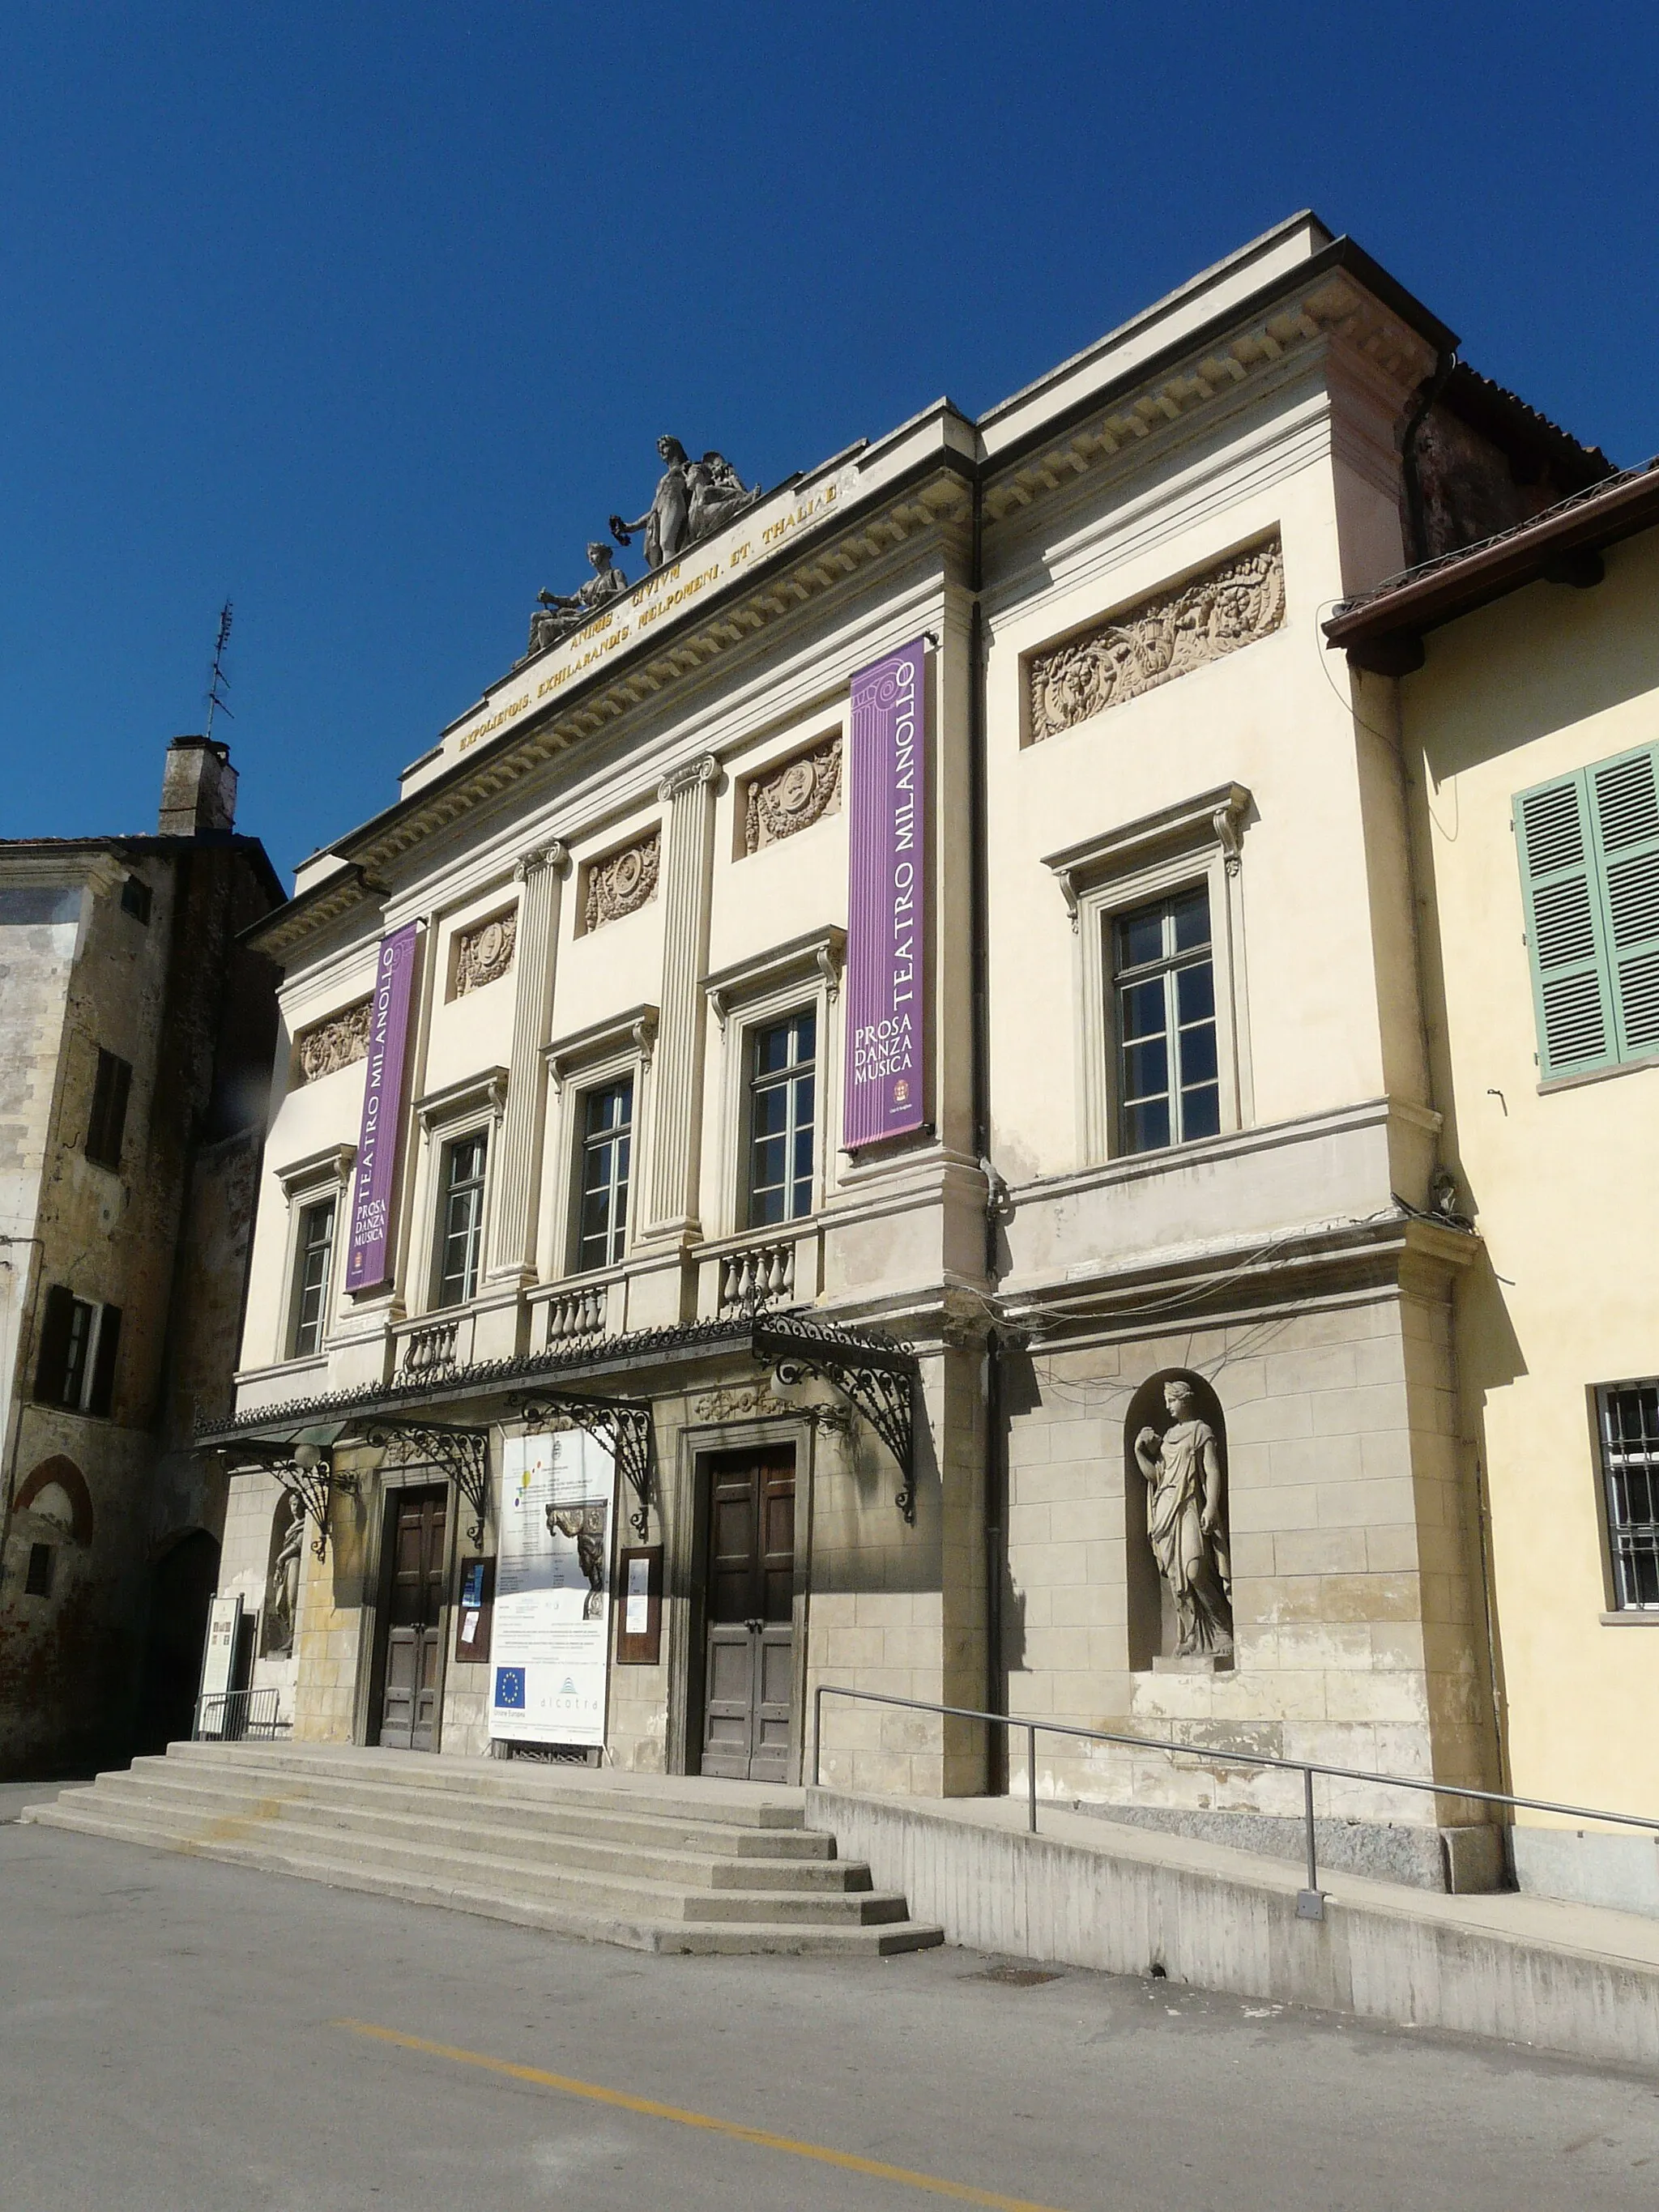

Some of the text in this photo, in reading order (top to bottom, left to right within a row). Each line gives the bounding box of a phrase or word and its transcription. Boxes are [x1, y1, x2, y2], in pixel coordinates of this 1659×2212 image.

[632, 564, 680, 607] CIVIVM
[893, 662, 915, 1012] TEATRO MILANOLLO
[855, 1013, 912, 1048] PROSA
[855, 1034, 912, 1068] DANZA
[358, 947, 394, 1204] TEATRO MILANOLLO
[855, 1053, 912, 1085] MUSICA
[356, 1199, 386, 1221] PROSA
[356, 1214, 385, 1234] DANZA
[354, 1227, 383, 1247] MUSICA
[540, 1698, 598, 1711] alcotra
